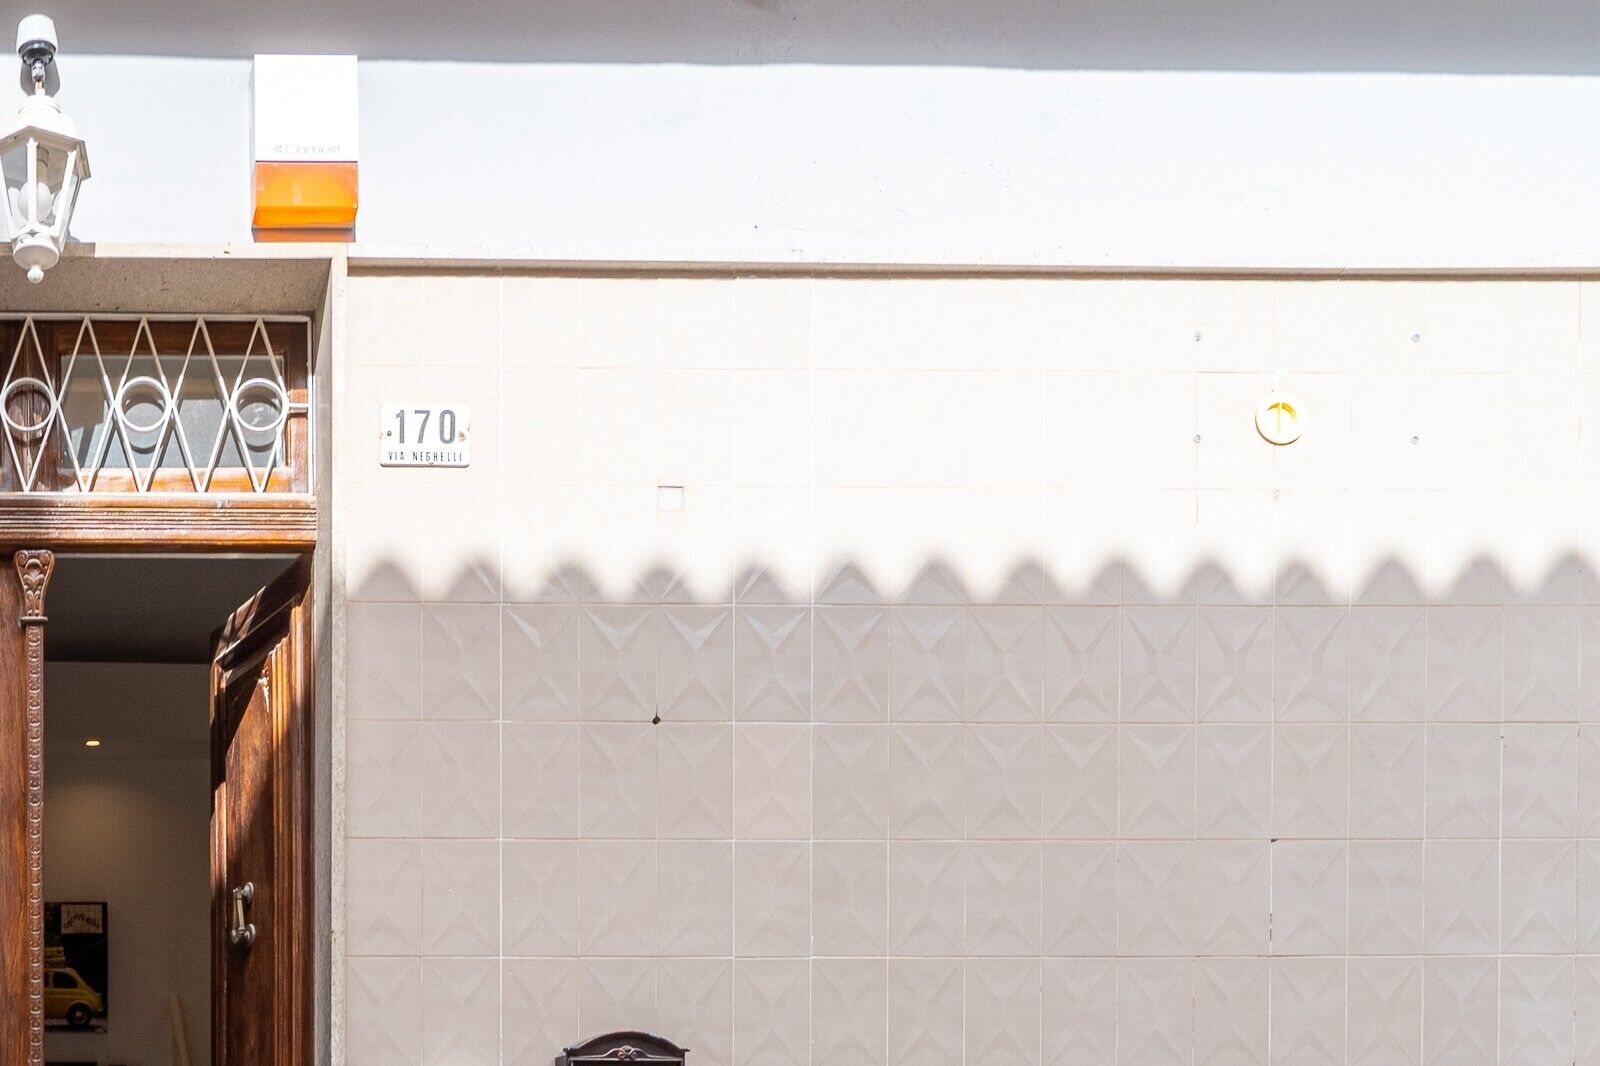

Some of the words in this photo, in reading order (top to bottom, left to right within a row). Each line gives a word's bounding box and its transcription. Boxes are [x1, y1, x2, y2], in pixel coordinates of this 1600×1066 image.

[395, 409, 456, 444] 170
[388, 451, 405, 461] VIA
[412, 451, 462, 462] NEGHELLI
